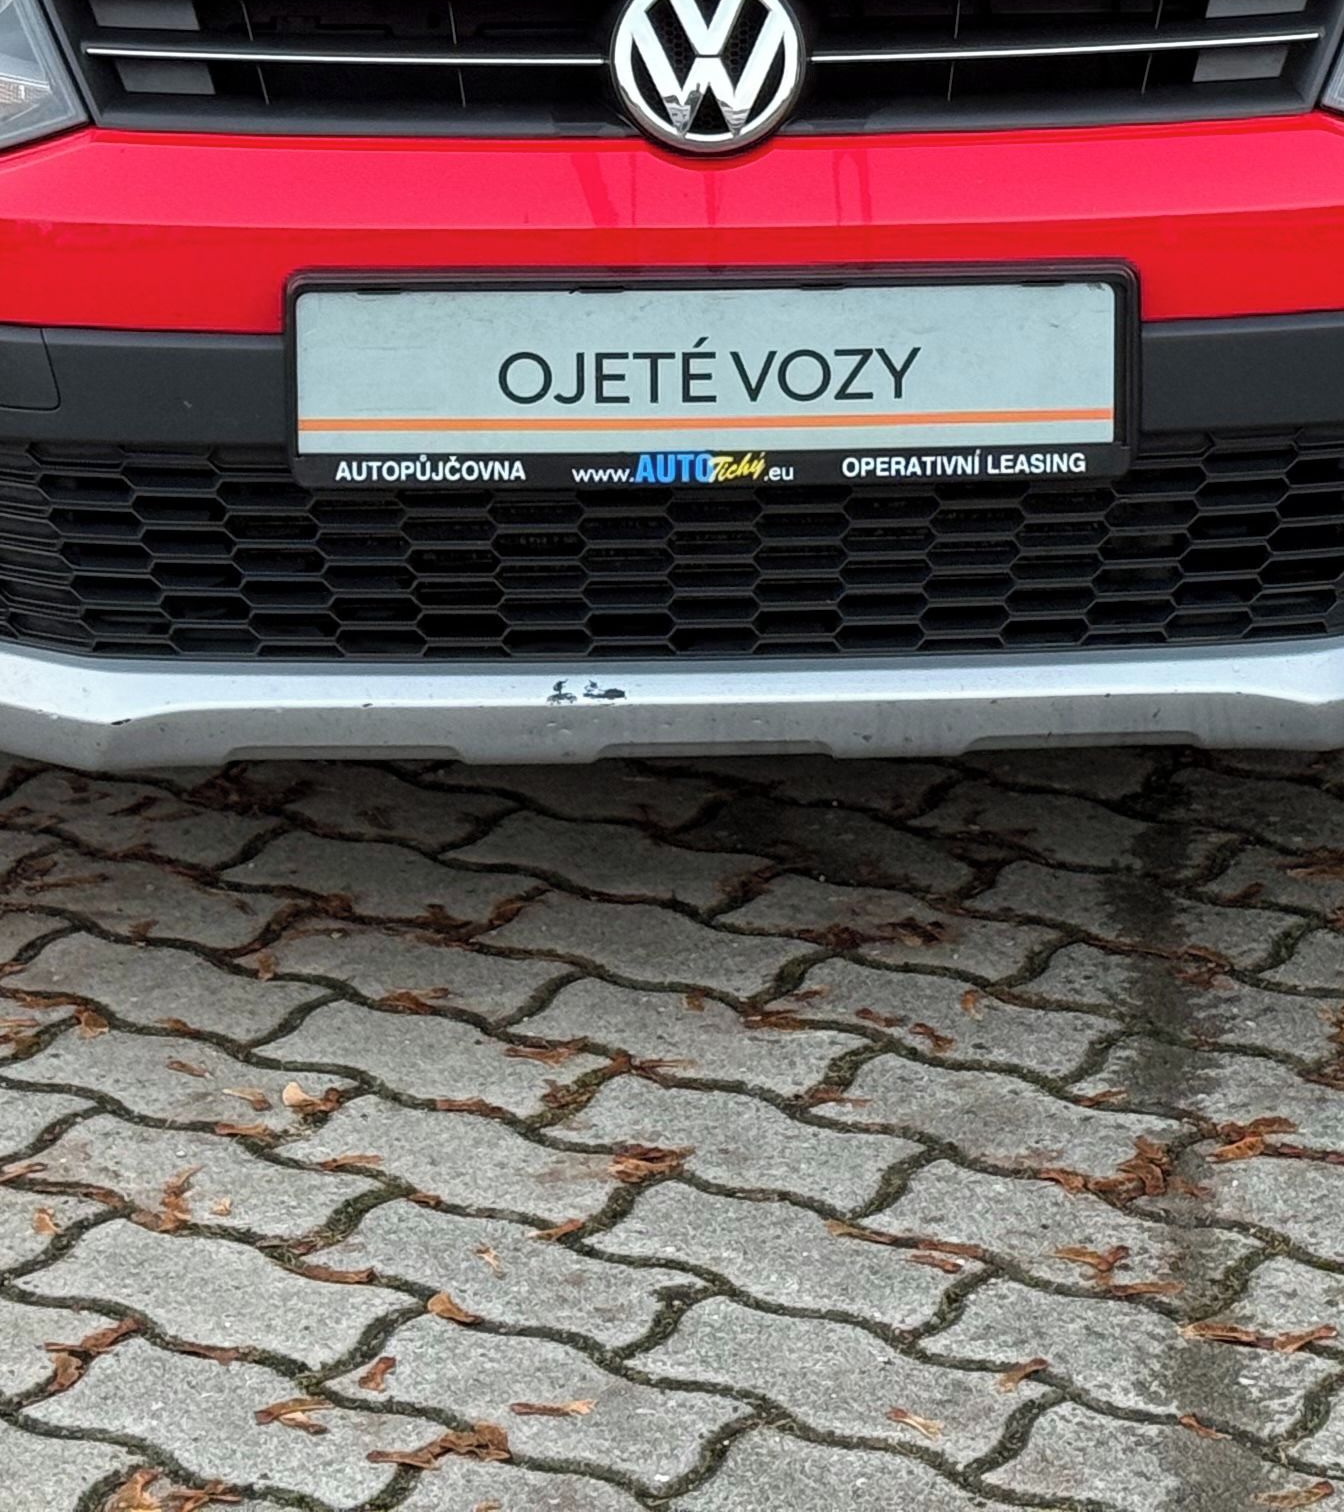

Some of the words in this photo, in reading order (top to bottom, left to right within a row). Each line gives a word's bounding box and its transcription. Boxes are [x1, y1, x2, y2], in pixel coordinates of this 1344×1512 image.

[498, 336, 717, 405] OJETÉ
[729, 346, 922, 402] VOZY
[335, 454, 527, 481] AUTOPŮJČOVNA
[841, 449, 981, 477] OPERATIVNÍ
[987, 452, 1086, 475] LEASING
